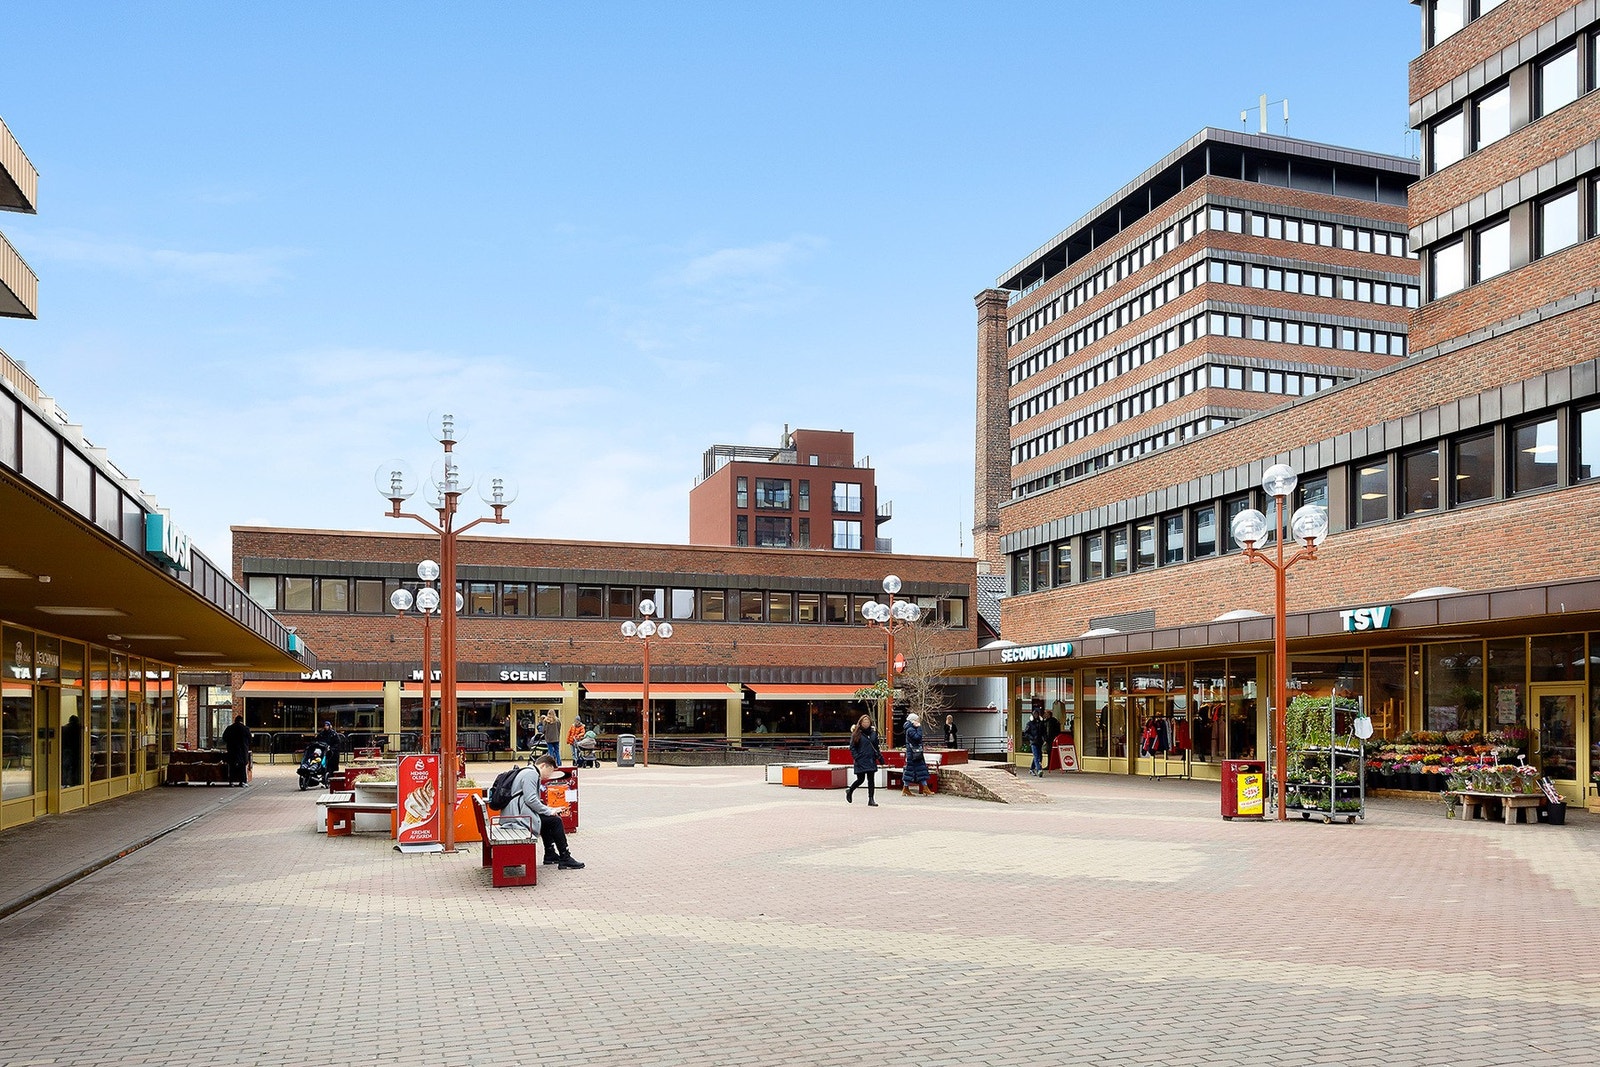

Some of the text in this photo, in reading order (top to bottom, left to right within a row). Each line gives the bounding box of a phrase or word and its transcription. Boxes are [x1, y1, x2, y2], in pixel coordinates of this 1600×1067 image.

[1339, 606, 1389, 630] TSV
[1001, 642, 1070, 663] SECOND HAND
[301, 669, 332, 680] BAR
[500, 670, 547, 681] SCENE
